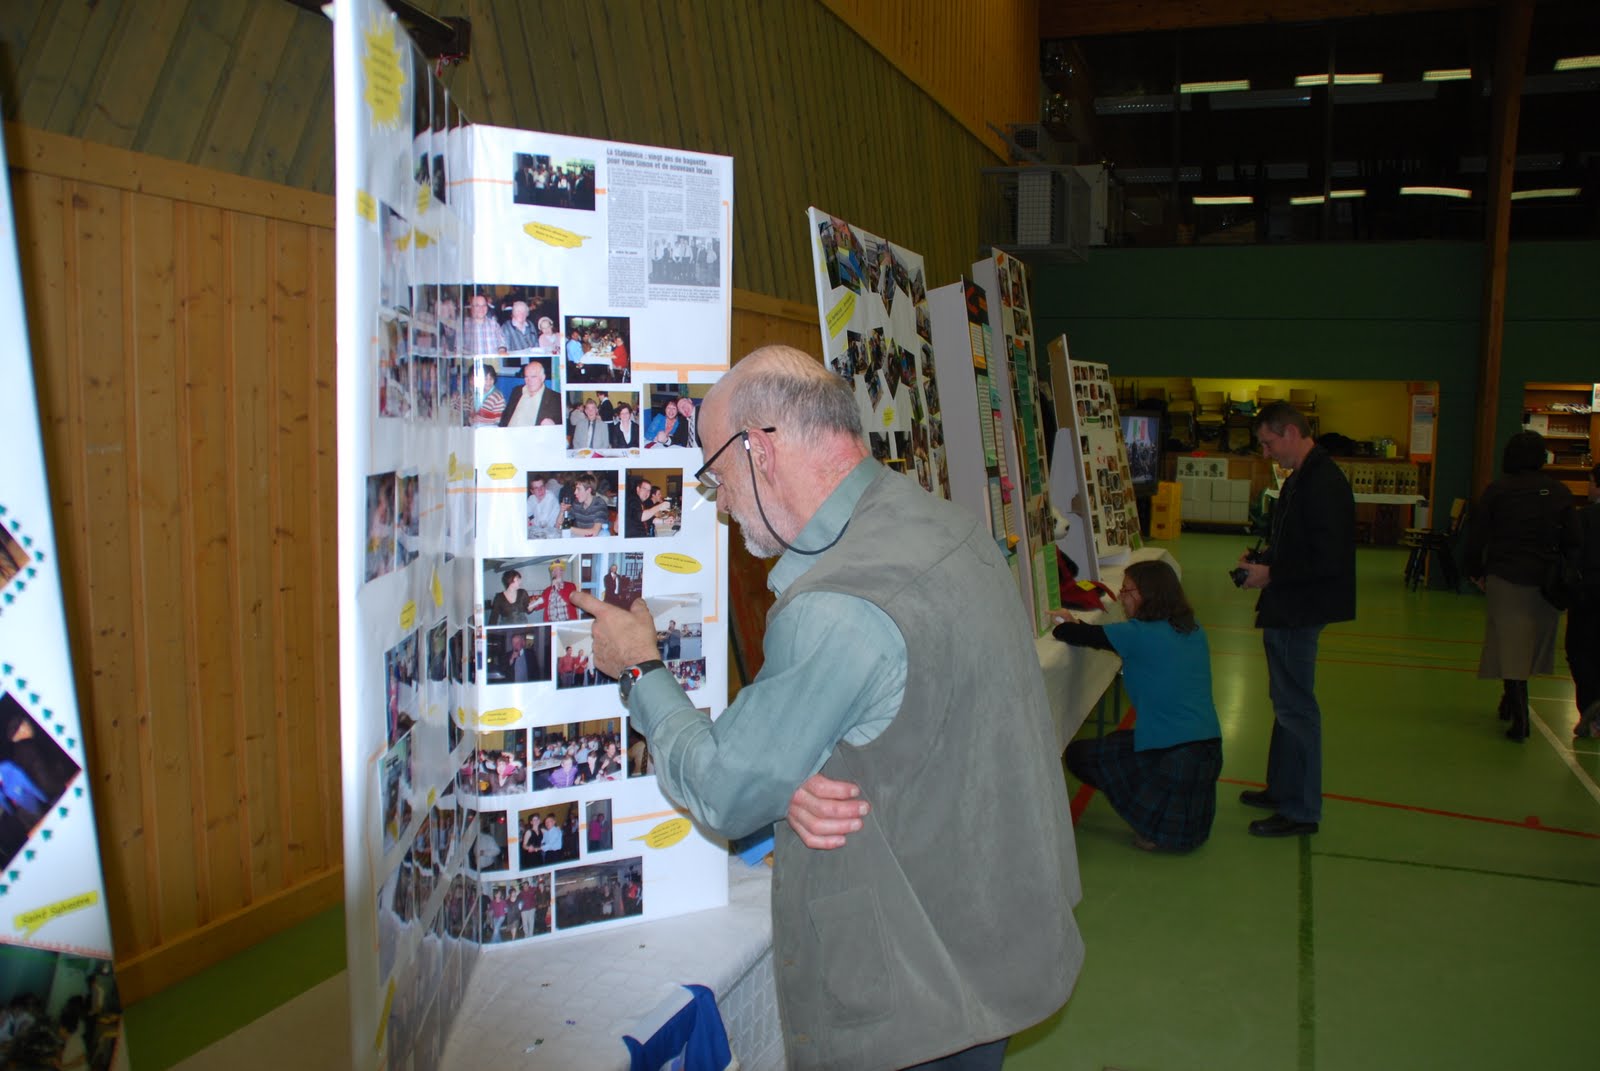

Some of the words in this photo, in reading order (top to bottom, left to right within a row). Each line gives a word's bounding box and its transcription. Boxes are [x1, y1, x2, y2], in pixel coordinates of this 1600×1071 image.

[606, 157, 620, 165] pour
[636, 159, 653, 168] Simon
[662, 162, 669, 170] de
[670, 164, 695, 173] nouveaux
[696, 165, 712, 175] locaux
[607, 148, 613, 156] La
[648, 154, 663, 162] vingt
[682, 157, 707, 167] baguette
